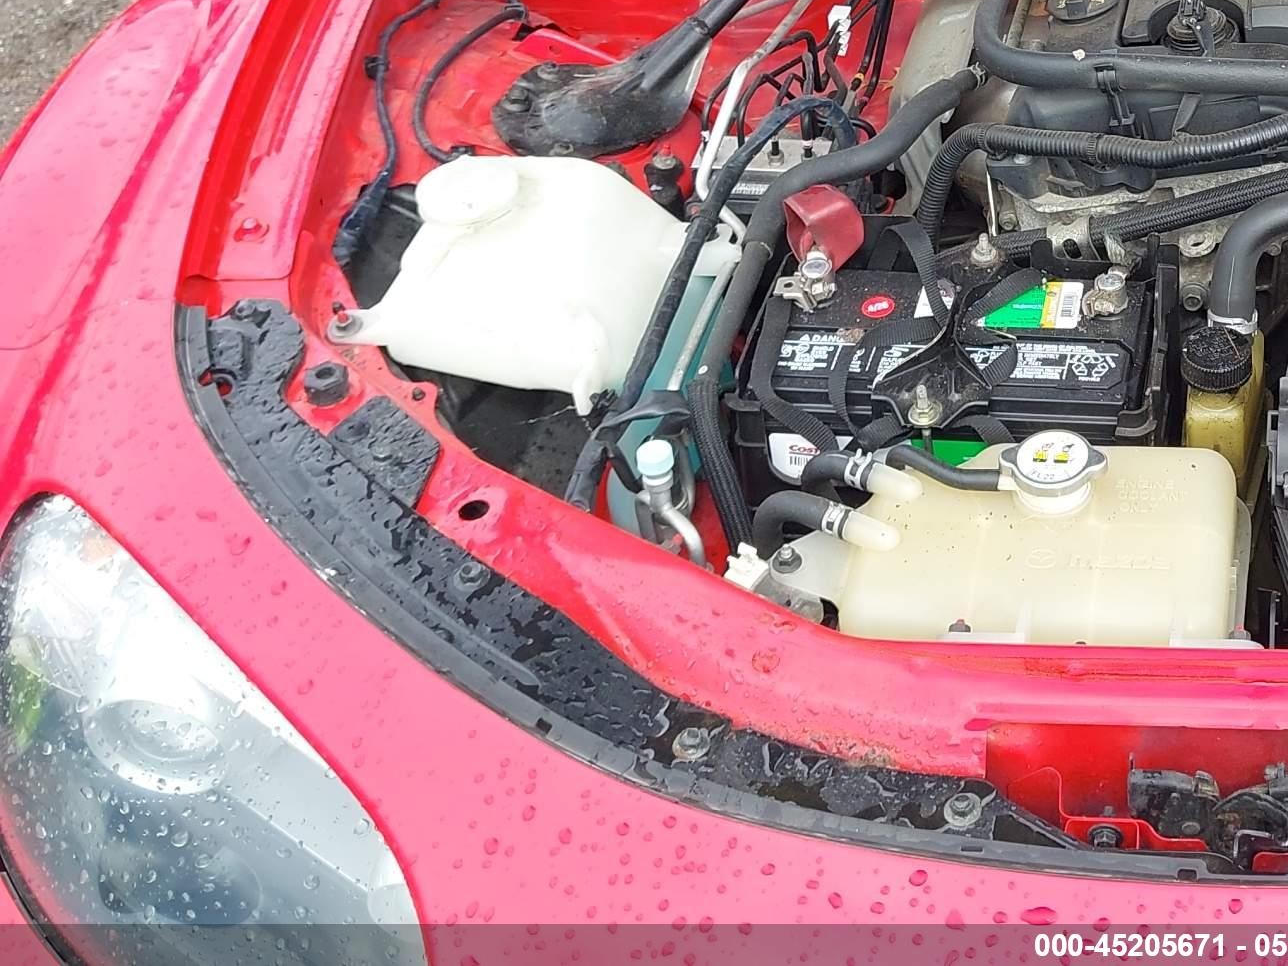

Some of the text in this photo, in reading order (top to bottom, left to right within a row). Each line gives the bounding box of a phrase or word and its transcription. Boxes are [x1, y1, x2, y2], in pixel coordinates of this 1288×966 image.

[1030, 469, 1056, 481] FL22
[1114, 479, 1176, 490] ENGINE
[1118, 489, 1190, 502] COOLANT
